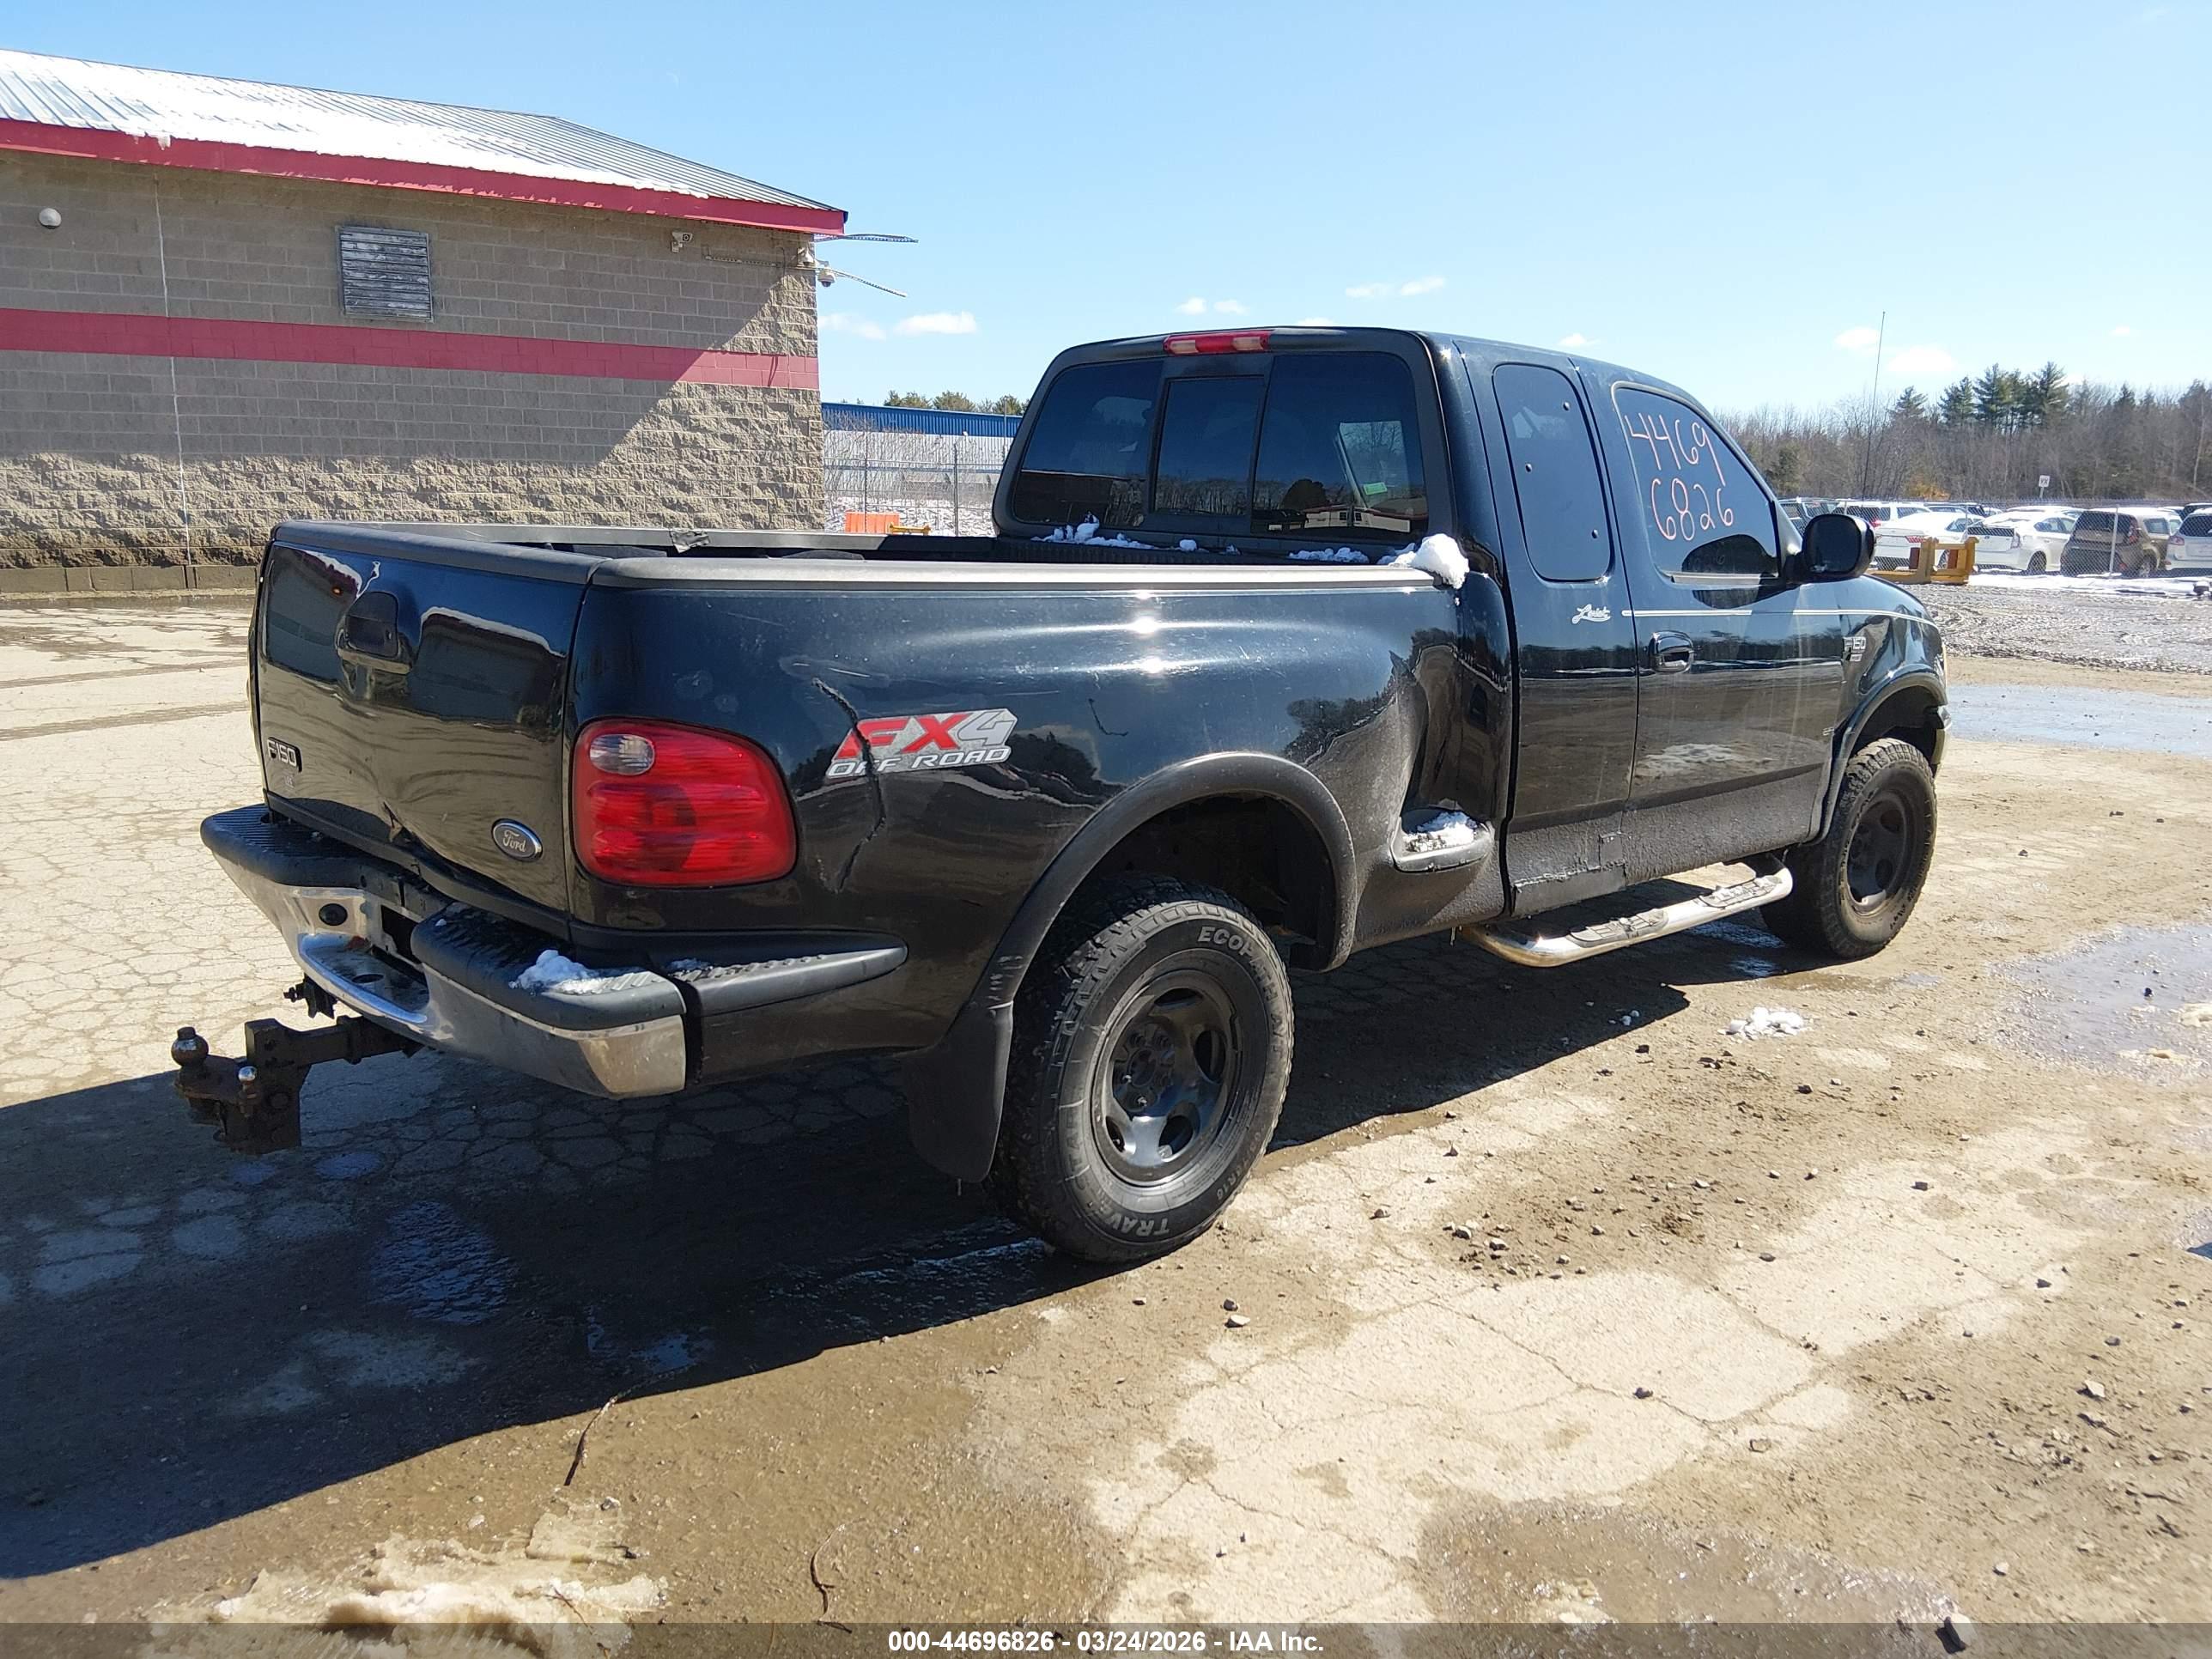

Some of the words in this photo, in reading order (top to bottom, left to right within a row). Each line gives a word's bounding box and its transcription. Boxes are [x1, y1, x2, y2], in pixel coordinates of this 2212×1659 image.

[1624, 412, 1726, 487] 4469
[1650, 477, 1735, 541] 6826
[834, 709, 1016, 760] FX4
[910, 748, 1012, 769] ROAD
[503, 830, 526, 852] Ford
